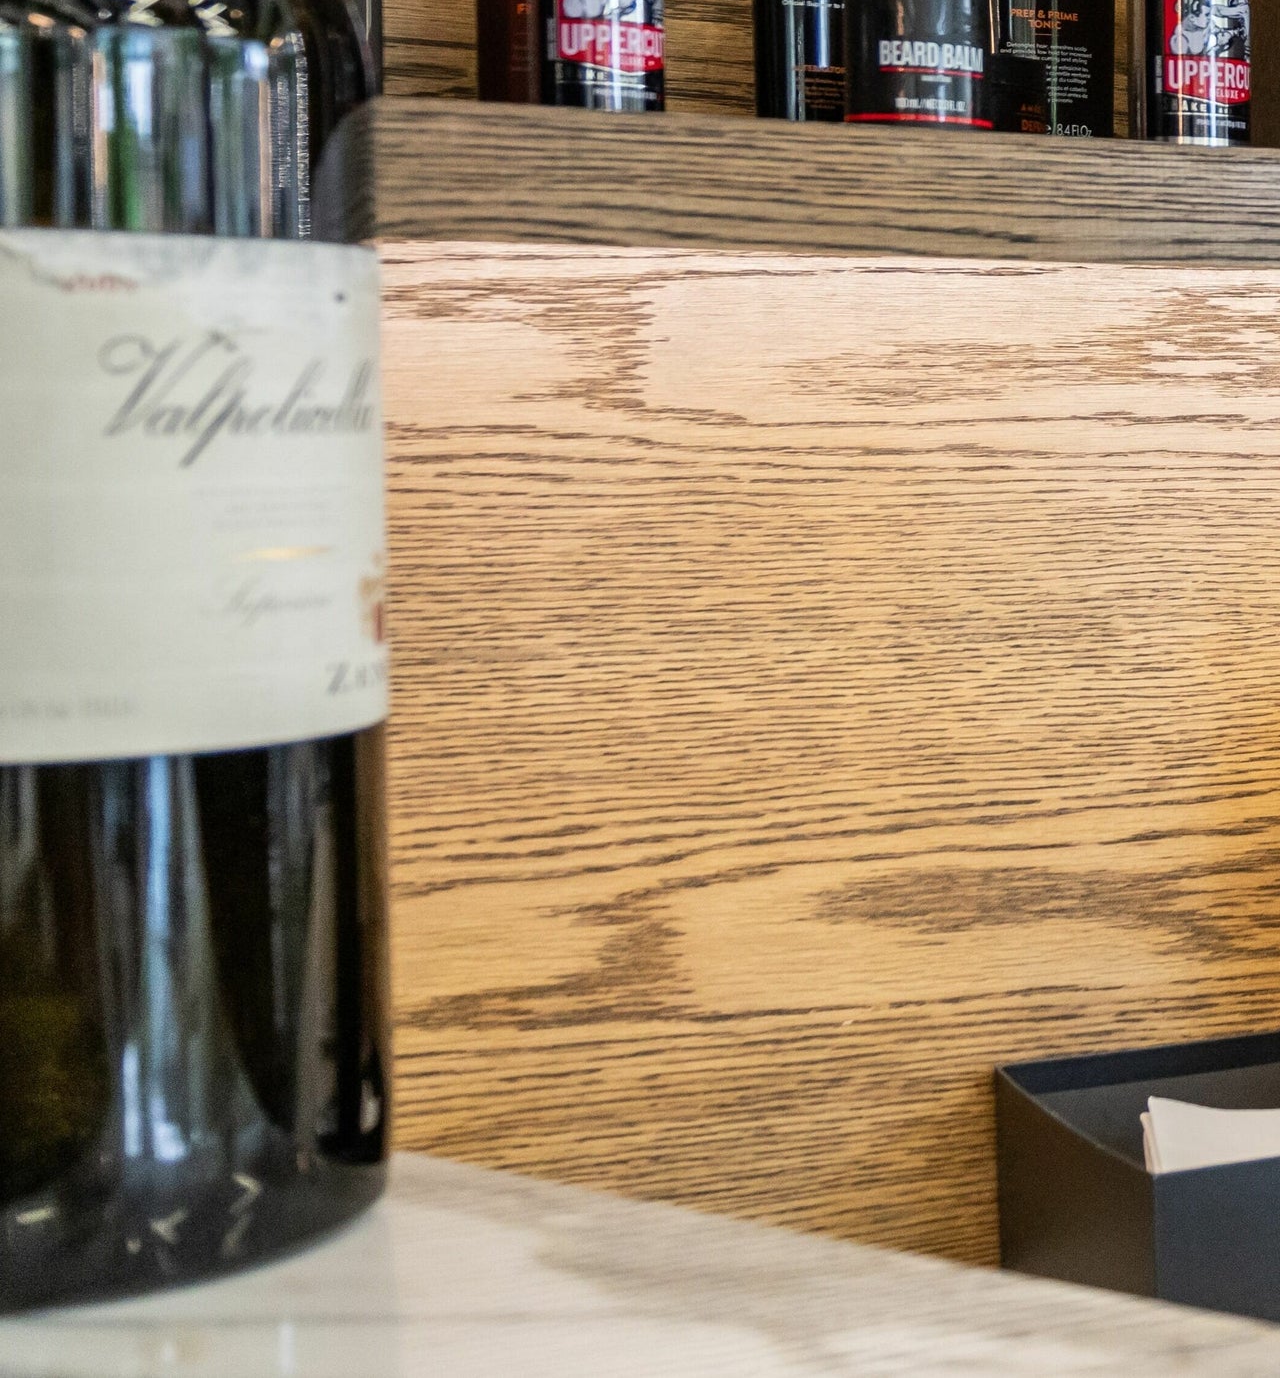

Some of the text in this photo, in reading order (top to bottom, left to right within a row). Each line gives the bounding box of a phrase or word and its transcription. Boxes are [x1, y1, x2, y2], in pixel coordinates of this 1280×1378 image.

[1010, 8, 1079, 22] PREP & PRIME
[1028, 19, 1062, 30] TONIC
[879, 40, 984, 73] BEARD BALM
